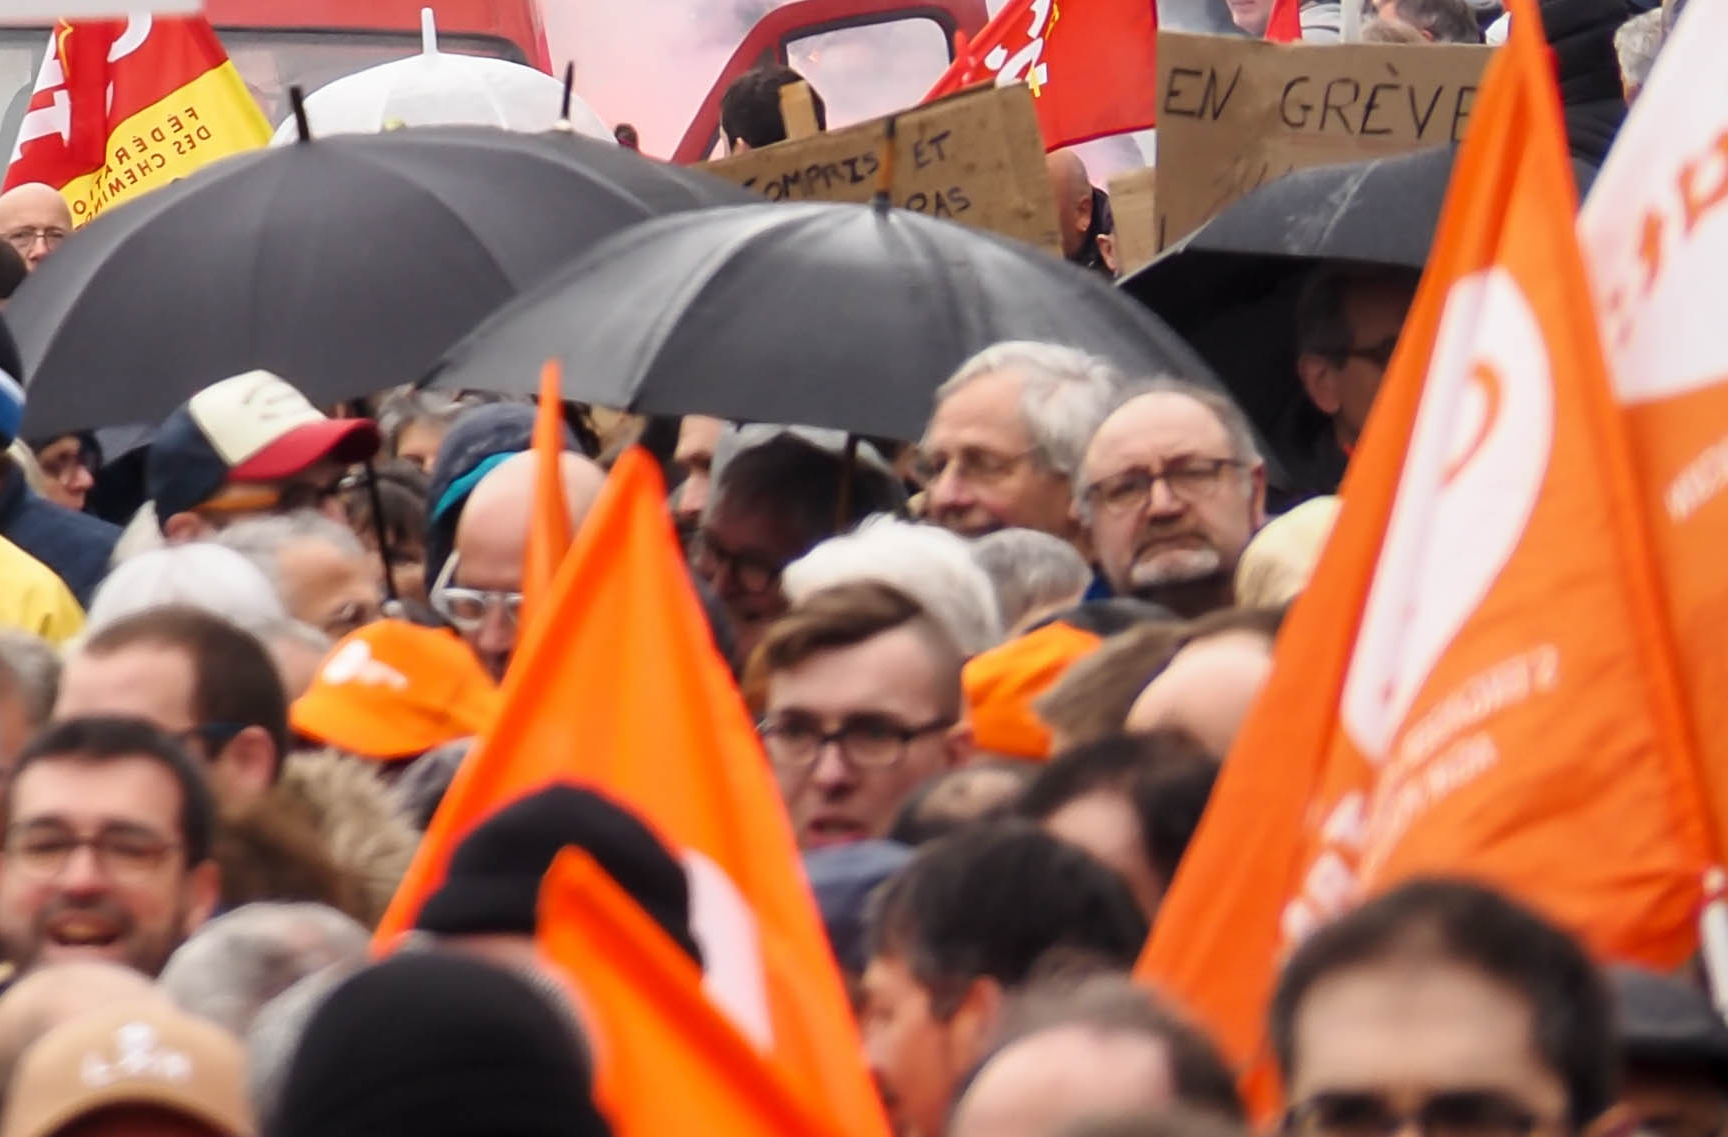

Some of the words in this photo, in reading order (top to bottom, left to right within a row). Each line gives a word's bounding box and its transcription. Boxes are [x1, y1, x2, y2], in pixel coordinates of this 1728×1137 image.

[1163, 65, 1242, 122] EN
[1279, 63, 1478, 143] GRÈVE
[912, 130, 951, 168] ET
